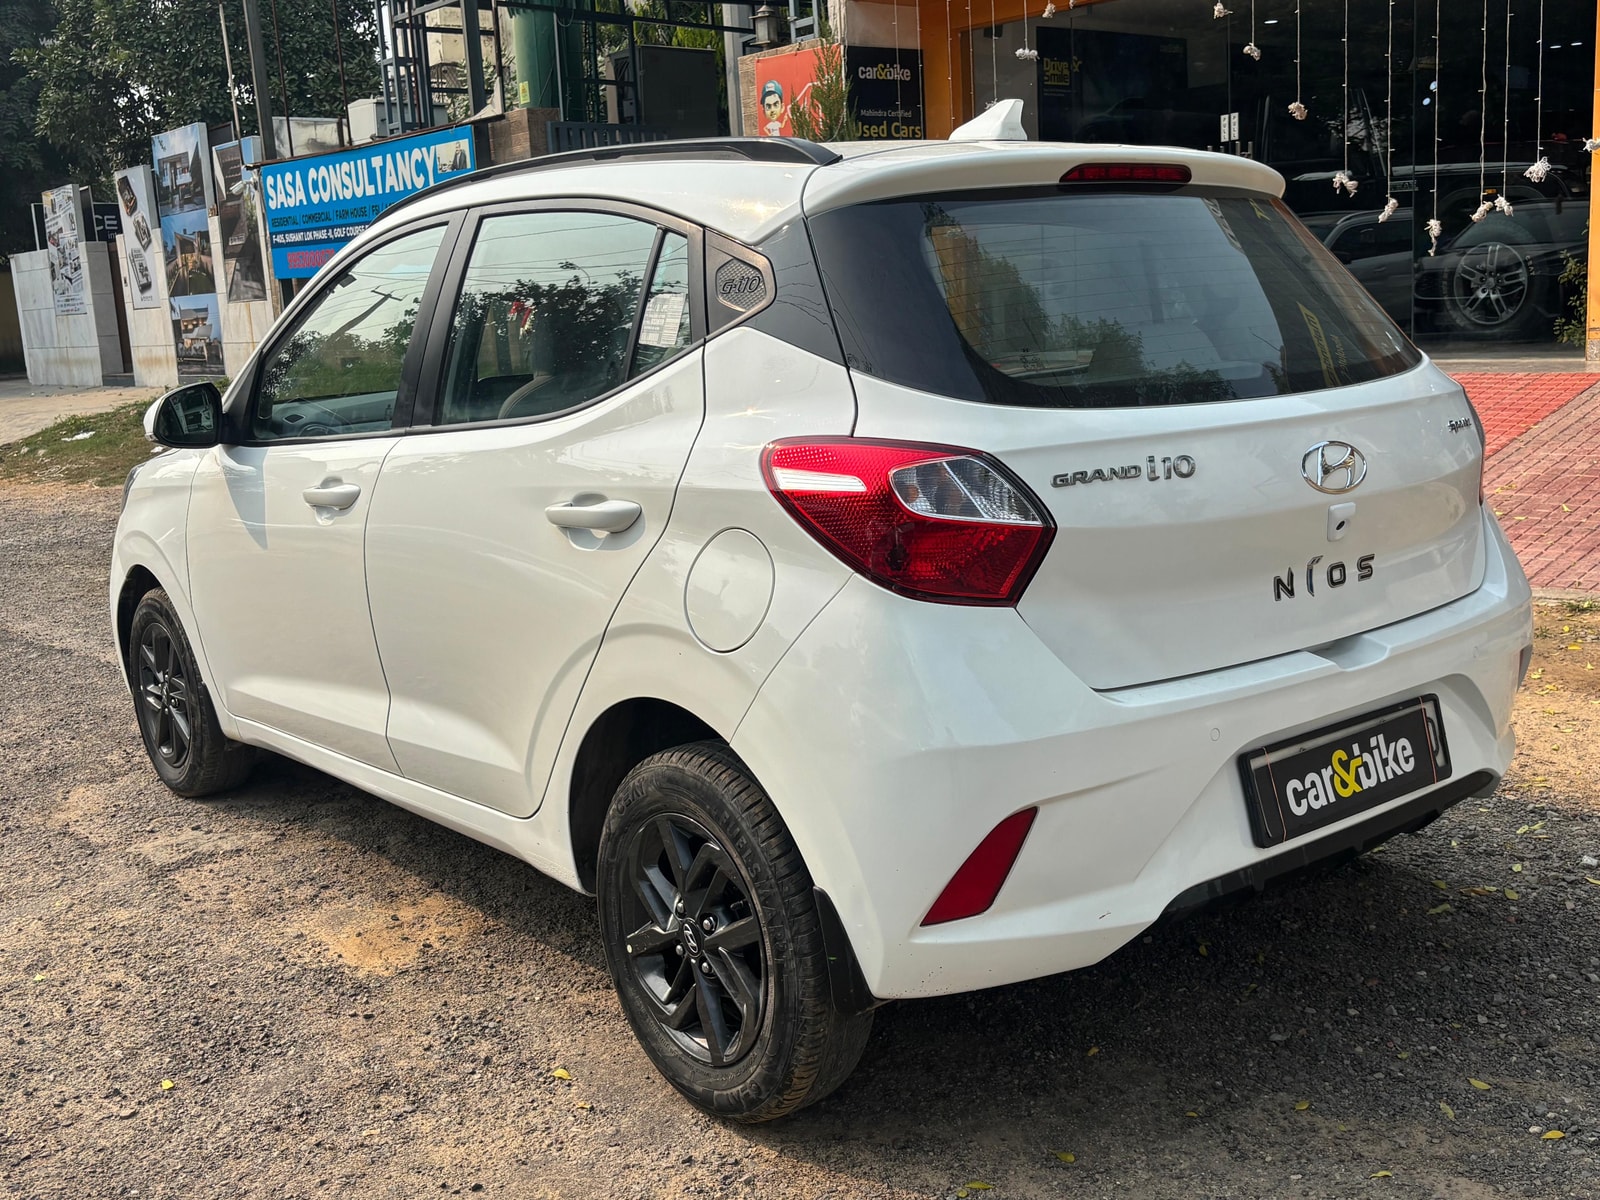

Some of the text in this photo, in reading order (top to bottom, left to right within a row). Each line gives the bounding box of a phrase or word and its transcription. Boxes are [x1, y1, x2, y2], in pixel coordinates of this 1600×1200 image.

[858, 63, 911, 82] car&bike
[861, 109, 912, 119] Mahindra Certified
[891, 122, 922, 139] Cars
[266, 145, 436, 210] SASA CONSULTANCY
[271, 215, 299, 228] RESIDENTIAL
[302, 211, 332, 224] COMMERCIAL
[336, 209, 350, 220] FARM
[350, 206, 368, 219] HOUSE
[334, 228, 346, 238] GOLF
[1050, 454, 1197, 488] GRAND i10
[1286, 733, 1415, 817] car&bike
